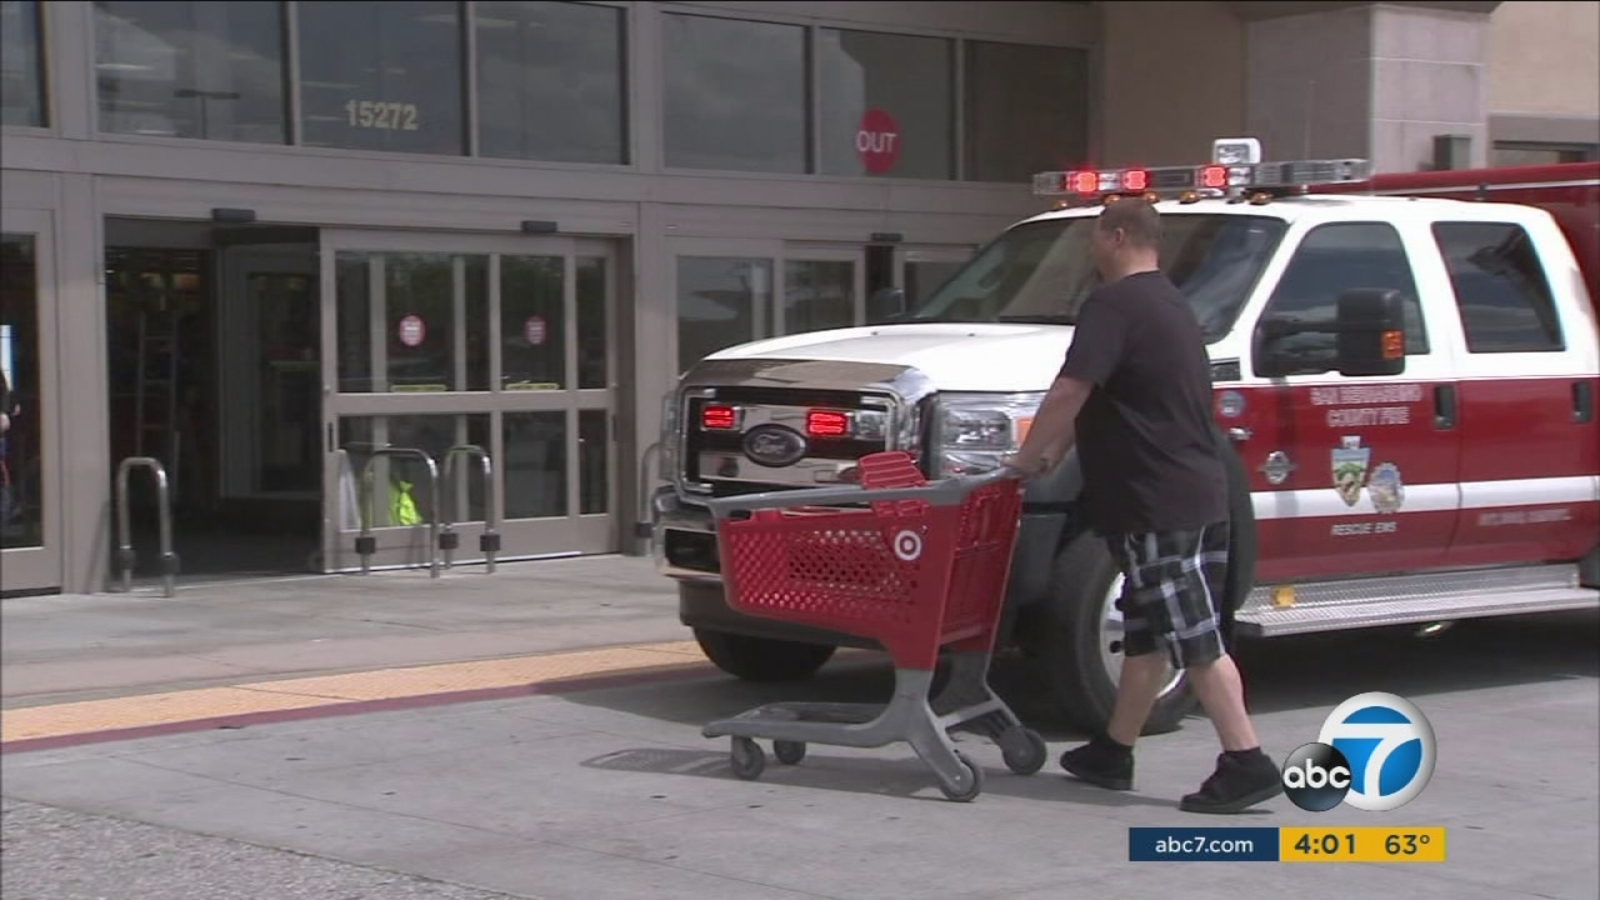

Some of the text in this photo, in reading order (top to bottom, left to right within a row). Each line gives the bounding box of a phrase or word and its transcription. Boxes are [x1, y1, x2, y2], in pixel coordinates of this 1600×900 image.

[345, 100, 419, 130] 15272
[856, 130, 897, 153] OUT
[1331, 523, 1372, 536] RESCUE
